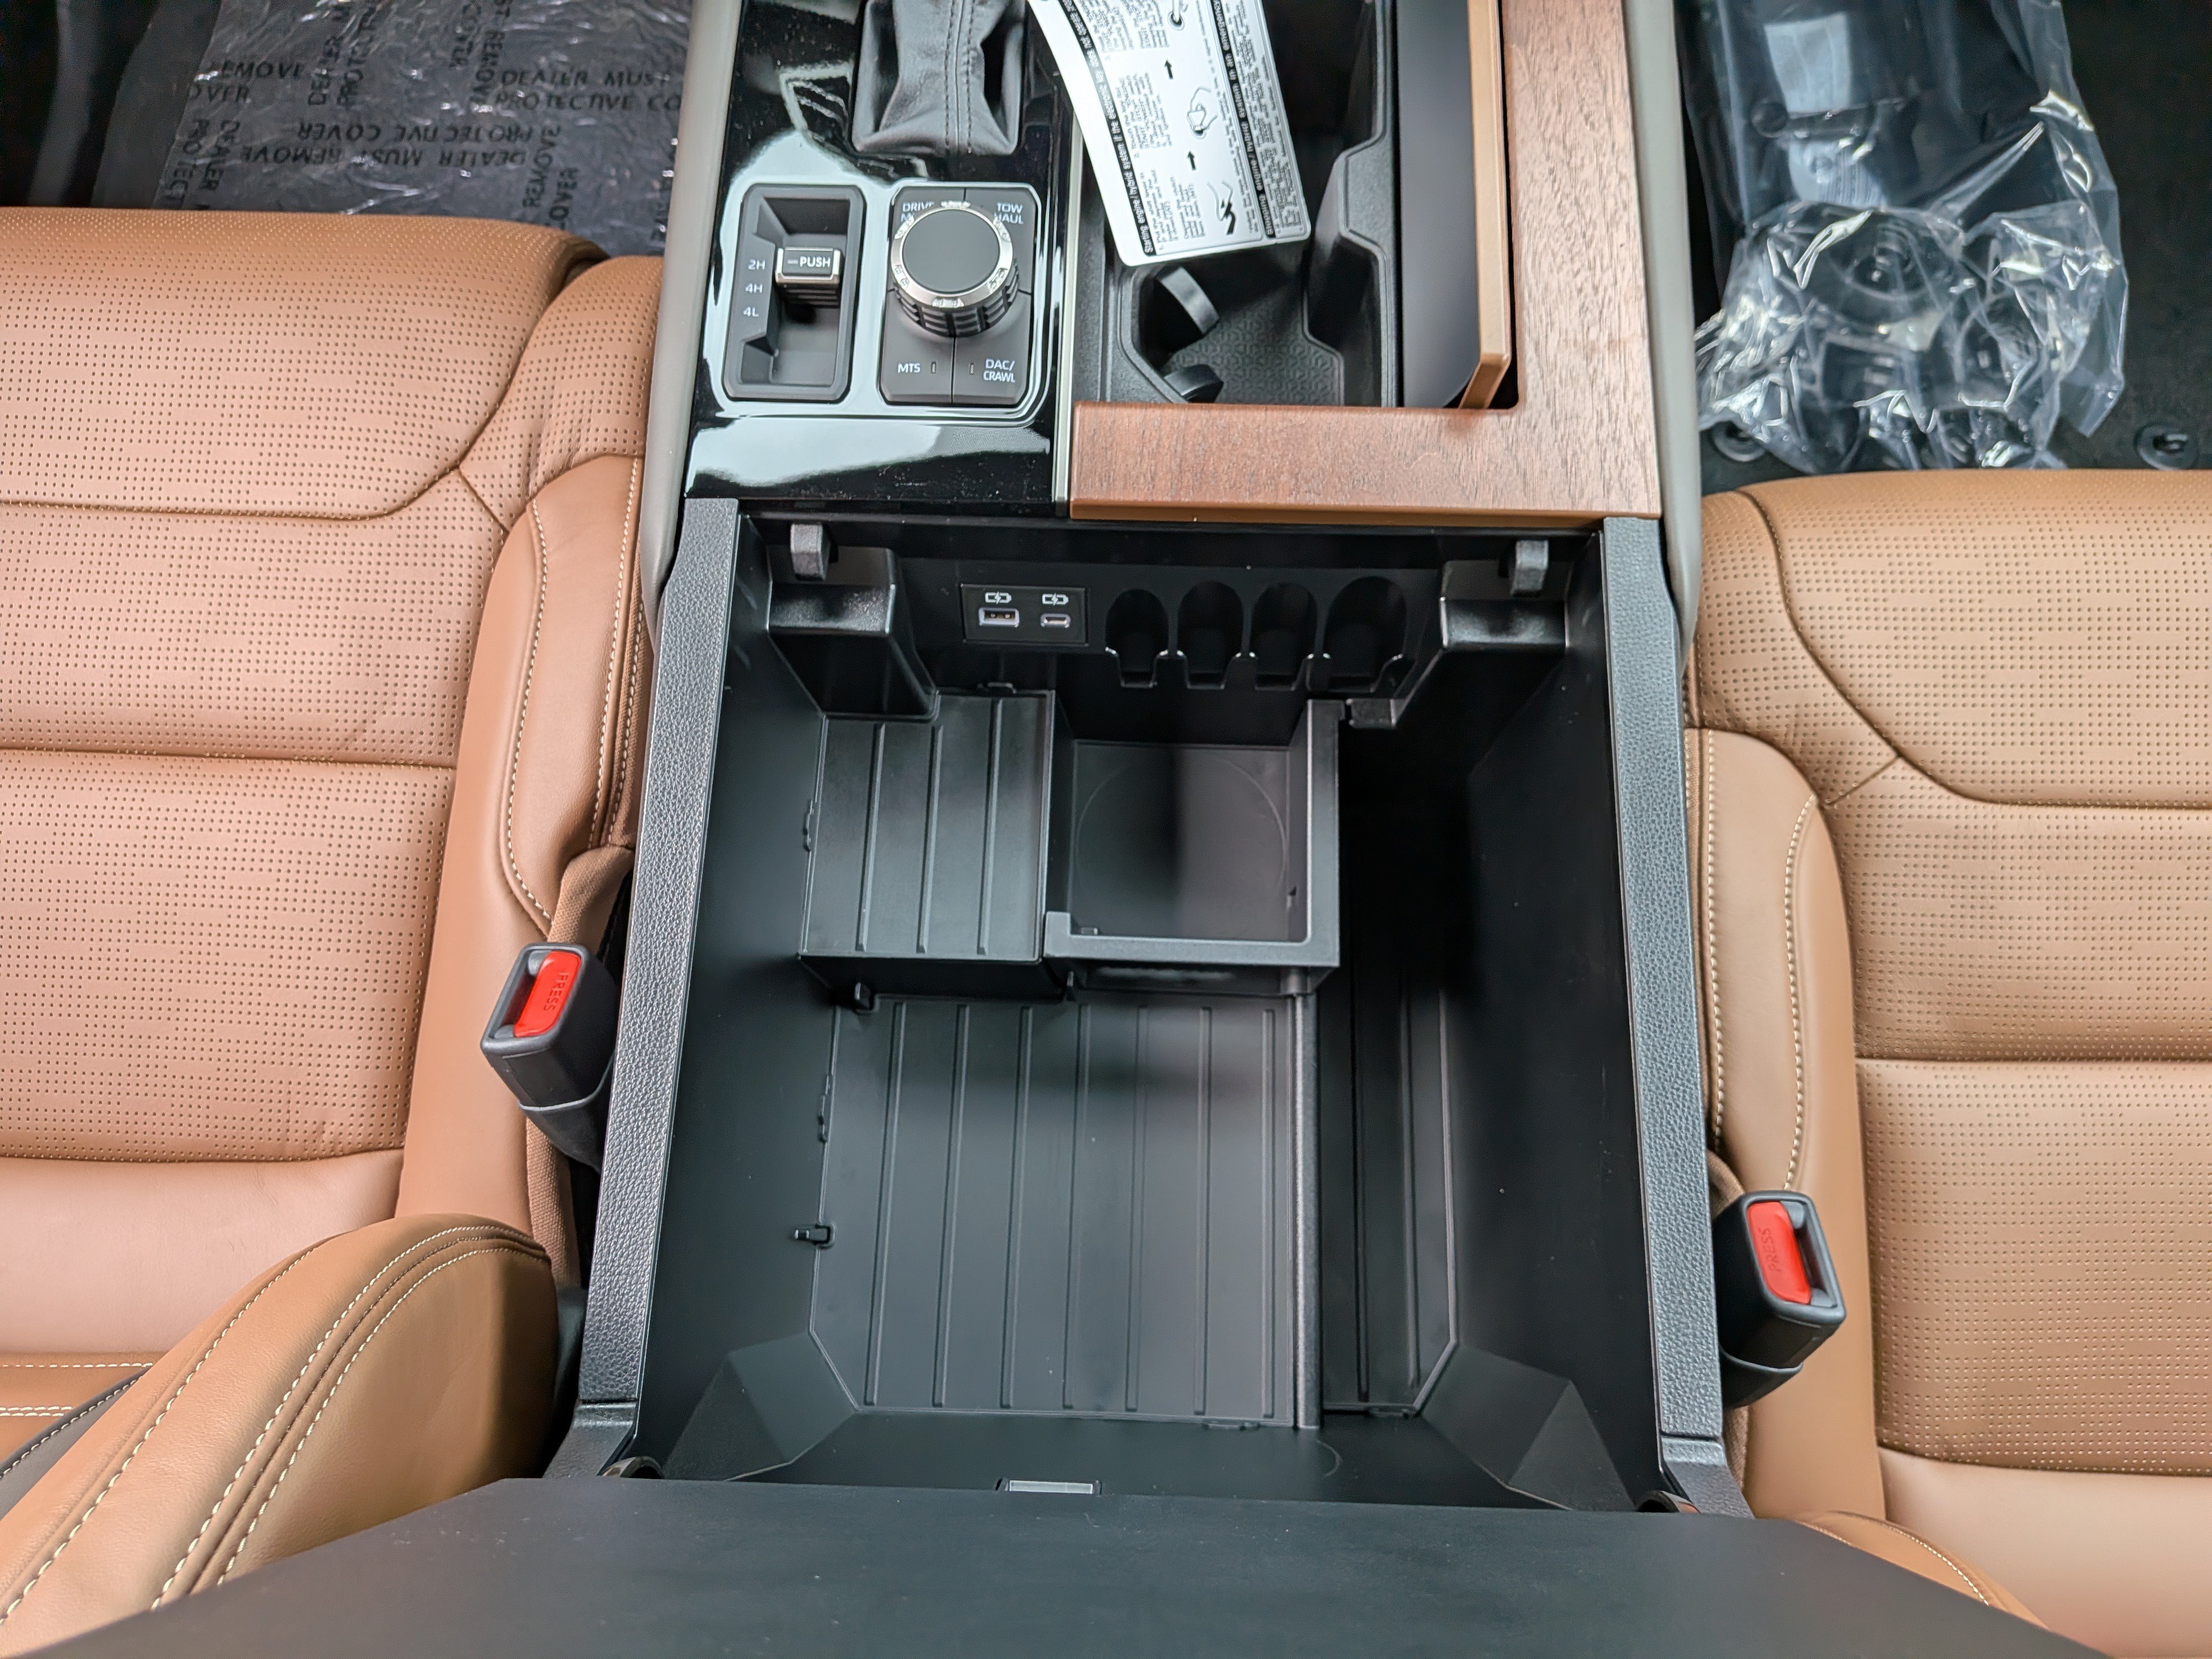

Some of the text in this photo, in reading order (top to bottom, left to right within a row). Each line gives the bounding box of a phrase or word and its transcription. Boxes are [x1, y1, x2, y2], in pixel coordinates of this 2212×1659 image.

[1231, 82, 1248, 118] system
[297, 122, 382, 142] COVER
[1108, 119, 1121, 134] the
[1115, 142, 1131, 170] system
[997, 201, 1023, 214] TOW
[1256, 192, 1276, 235] Stopping
[1137, 223, 1156, 253] Starting
[748, 259, 766, 270] 2H
[800, 256, 831, 268] PUSH
[745, 283, 763, 294] 4H
[743, 306, 759, 317] 4L
[897, 362, 921, 374] MTS
[985, 358, 1016, 372] DAC/
[983, 370, 1016, 383] CRAWL
[543, 972, 569, 1012] PRESS
